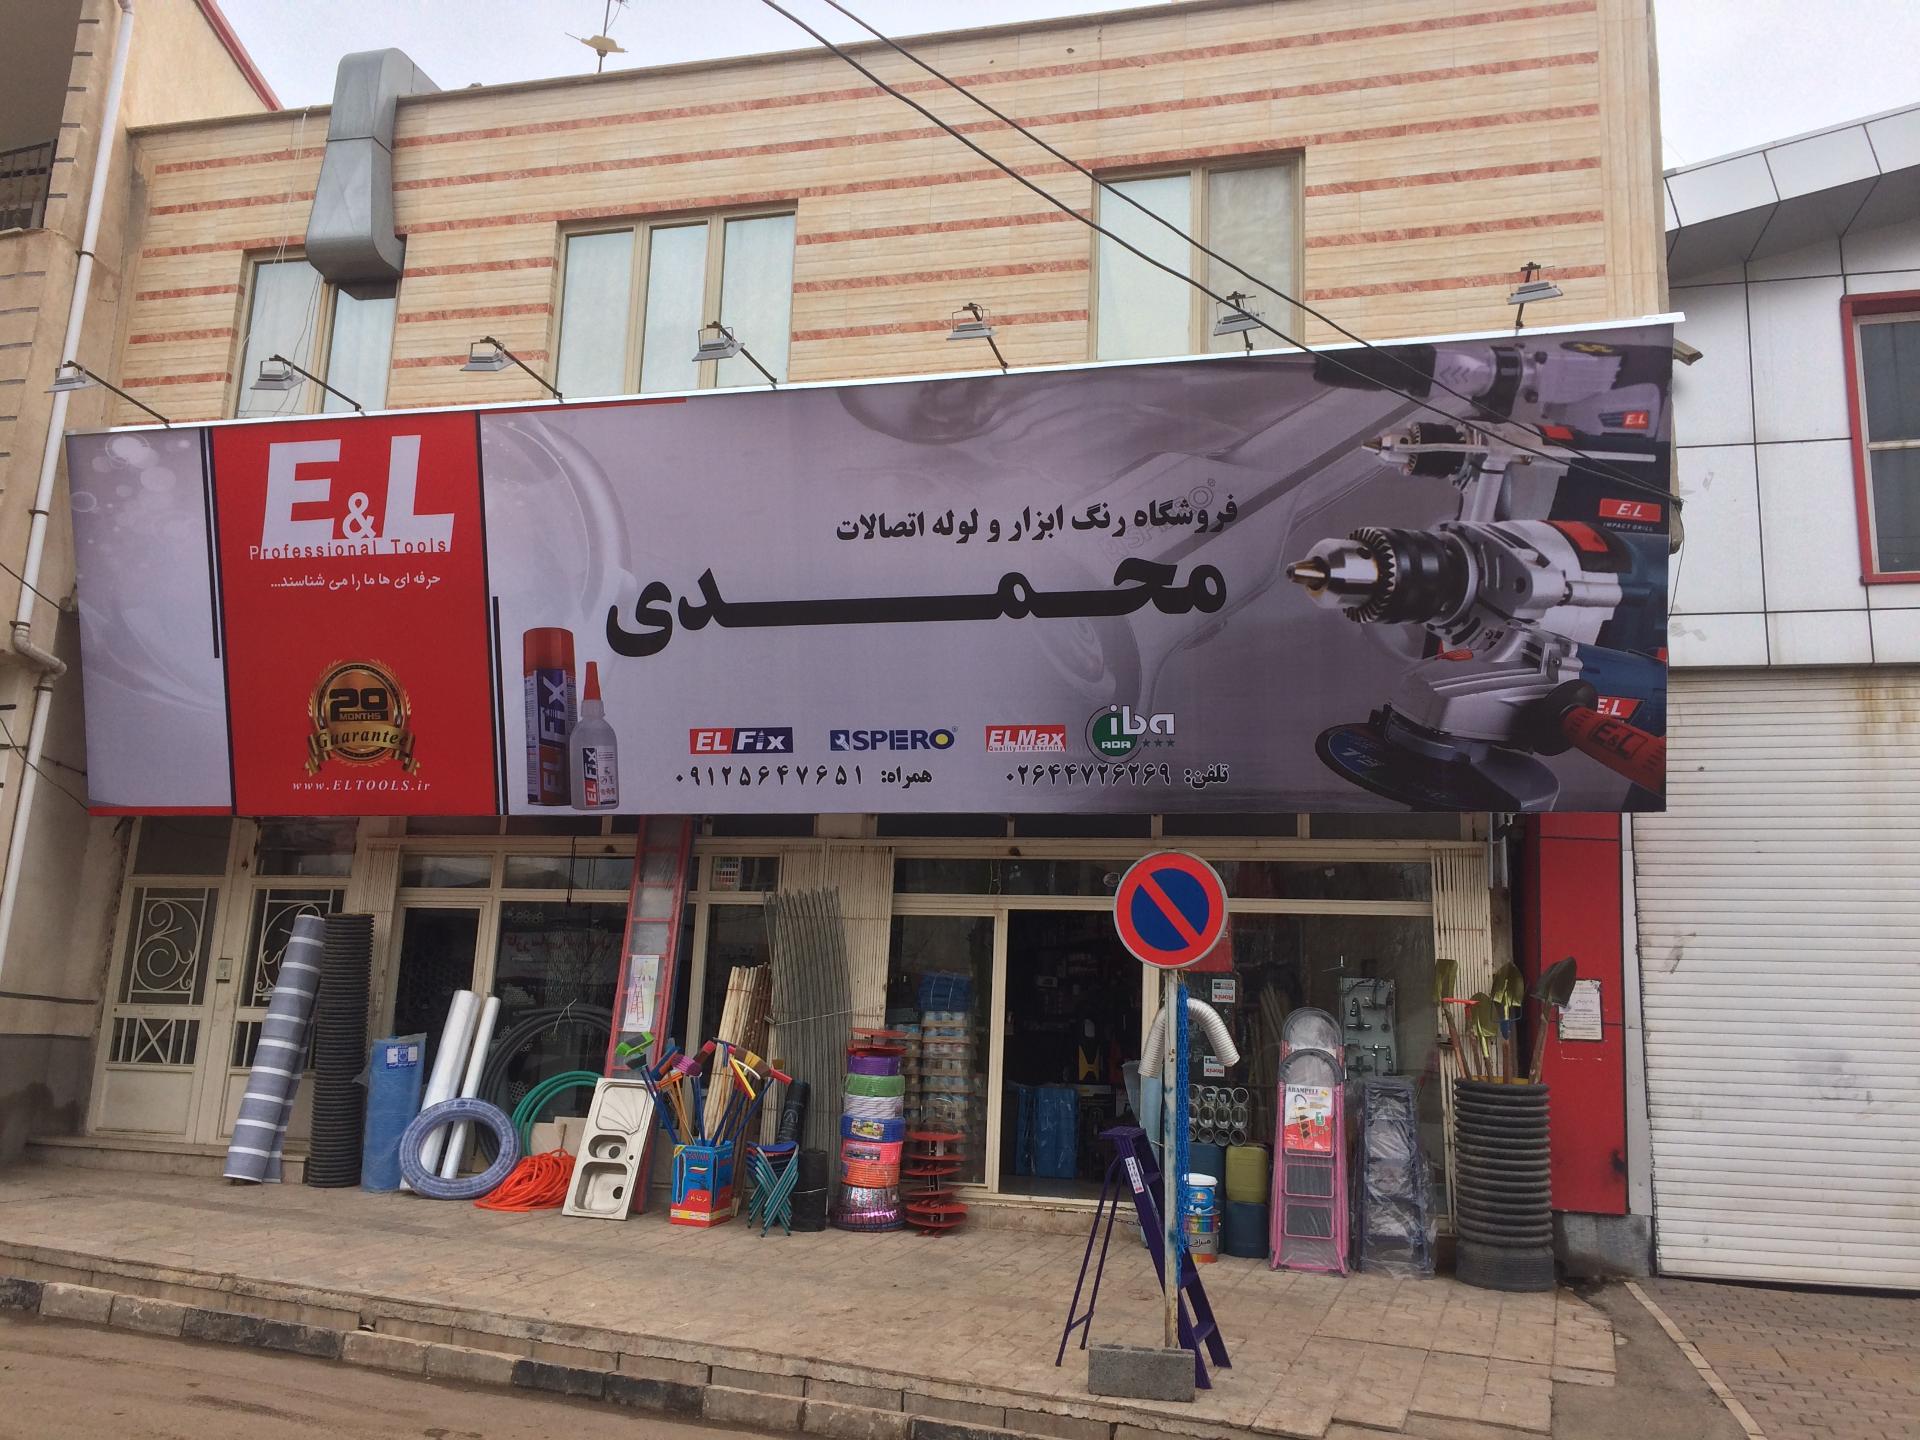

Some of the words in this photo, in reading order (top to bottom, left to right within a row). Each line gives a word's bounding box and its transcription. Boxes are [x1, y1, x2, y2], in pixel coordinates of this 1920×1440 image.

[260, 435, 455, 559] E&L
[1008, 504, 1064, 541] ابزار
[1071, 502, 1126, 537] رنگ
[1134, 493, 1239, 534] فروشگاه
[836, 511, 924, 542] اتصالات
[933, 508, 979, 544] لوله
[987, 521, 1001, 543] و
[250, 540, 377, 560] Professional
[391, 537, 446, 554] Tools
[328, 576, 348, 590] می
[351, 573, 361, 591] را
[363, 573, 375, 586] ما
[378, 573, 390, 585] ها
[394, 572, 410, 589] ای
[413, 571, 441, 590] حرفه
[605, 556, 1227, 658] محمدی
[329, 688, 388, 719] 20
[339, 712, 382, 721] MONTHS
[1109, 704, 1176, 736] iba
[317, 729, 409, 749] Guarantee
[988, 730, 1065, 747] ELMax
[988, 744, 1016, 753] Quality
[1032, 744, 1064, 752] Eternity
[676, 764, 862, 786] ۰۹۱۲۵۶۴۷۶۵۱
[881, 765, 933, 789] همراه:
[1006, 762, 1172, 786] ۰۲۶۴۴۷۲۶۲۶۹
[1184, 763, 1230, 789] تلفن:
[292, 779, 431, 792] www.ELTOOLS.ir
